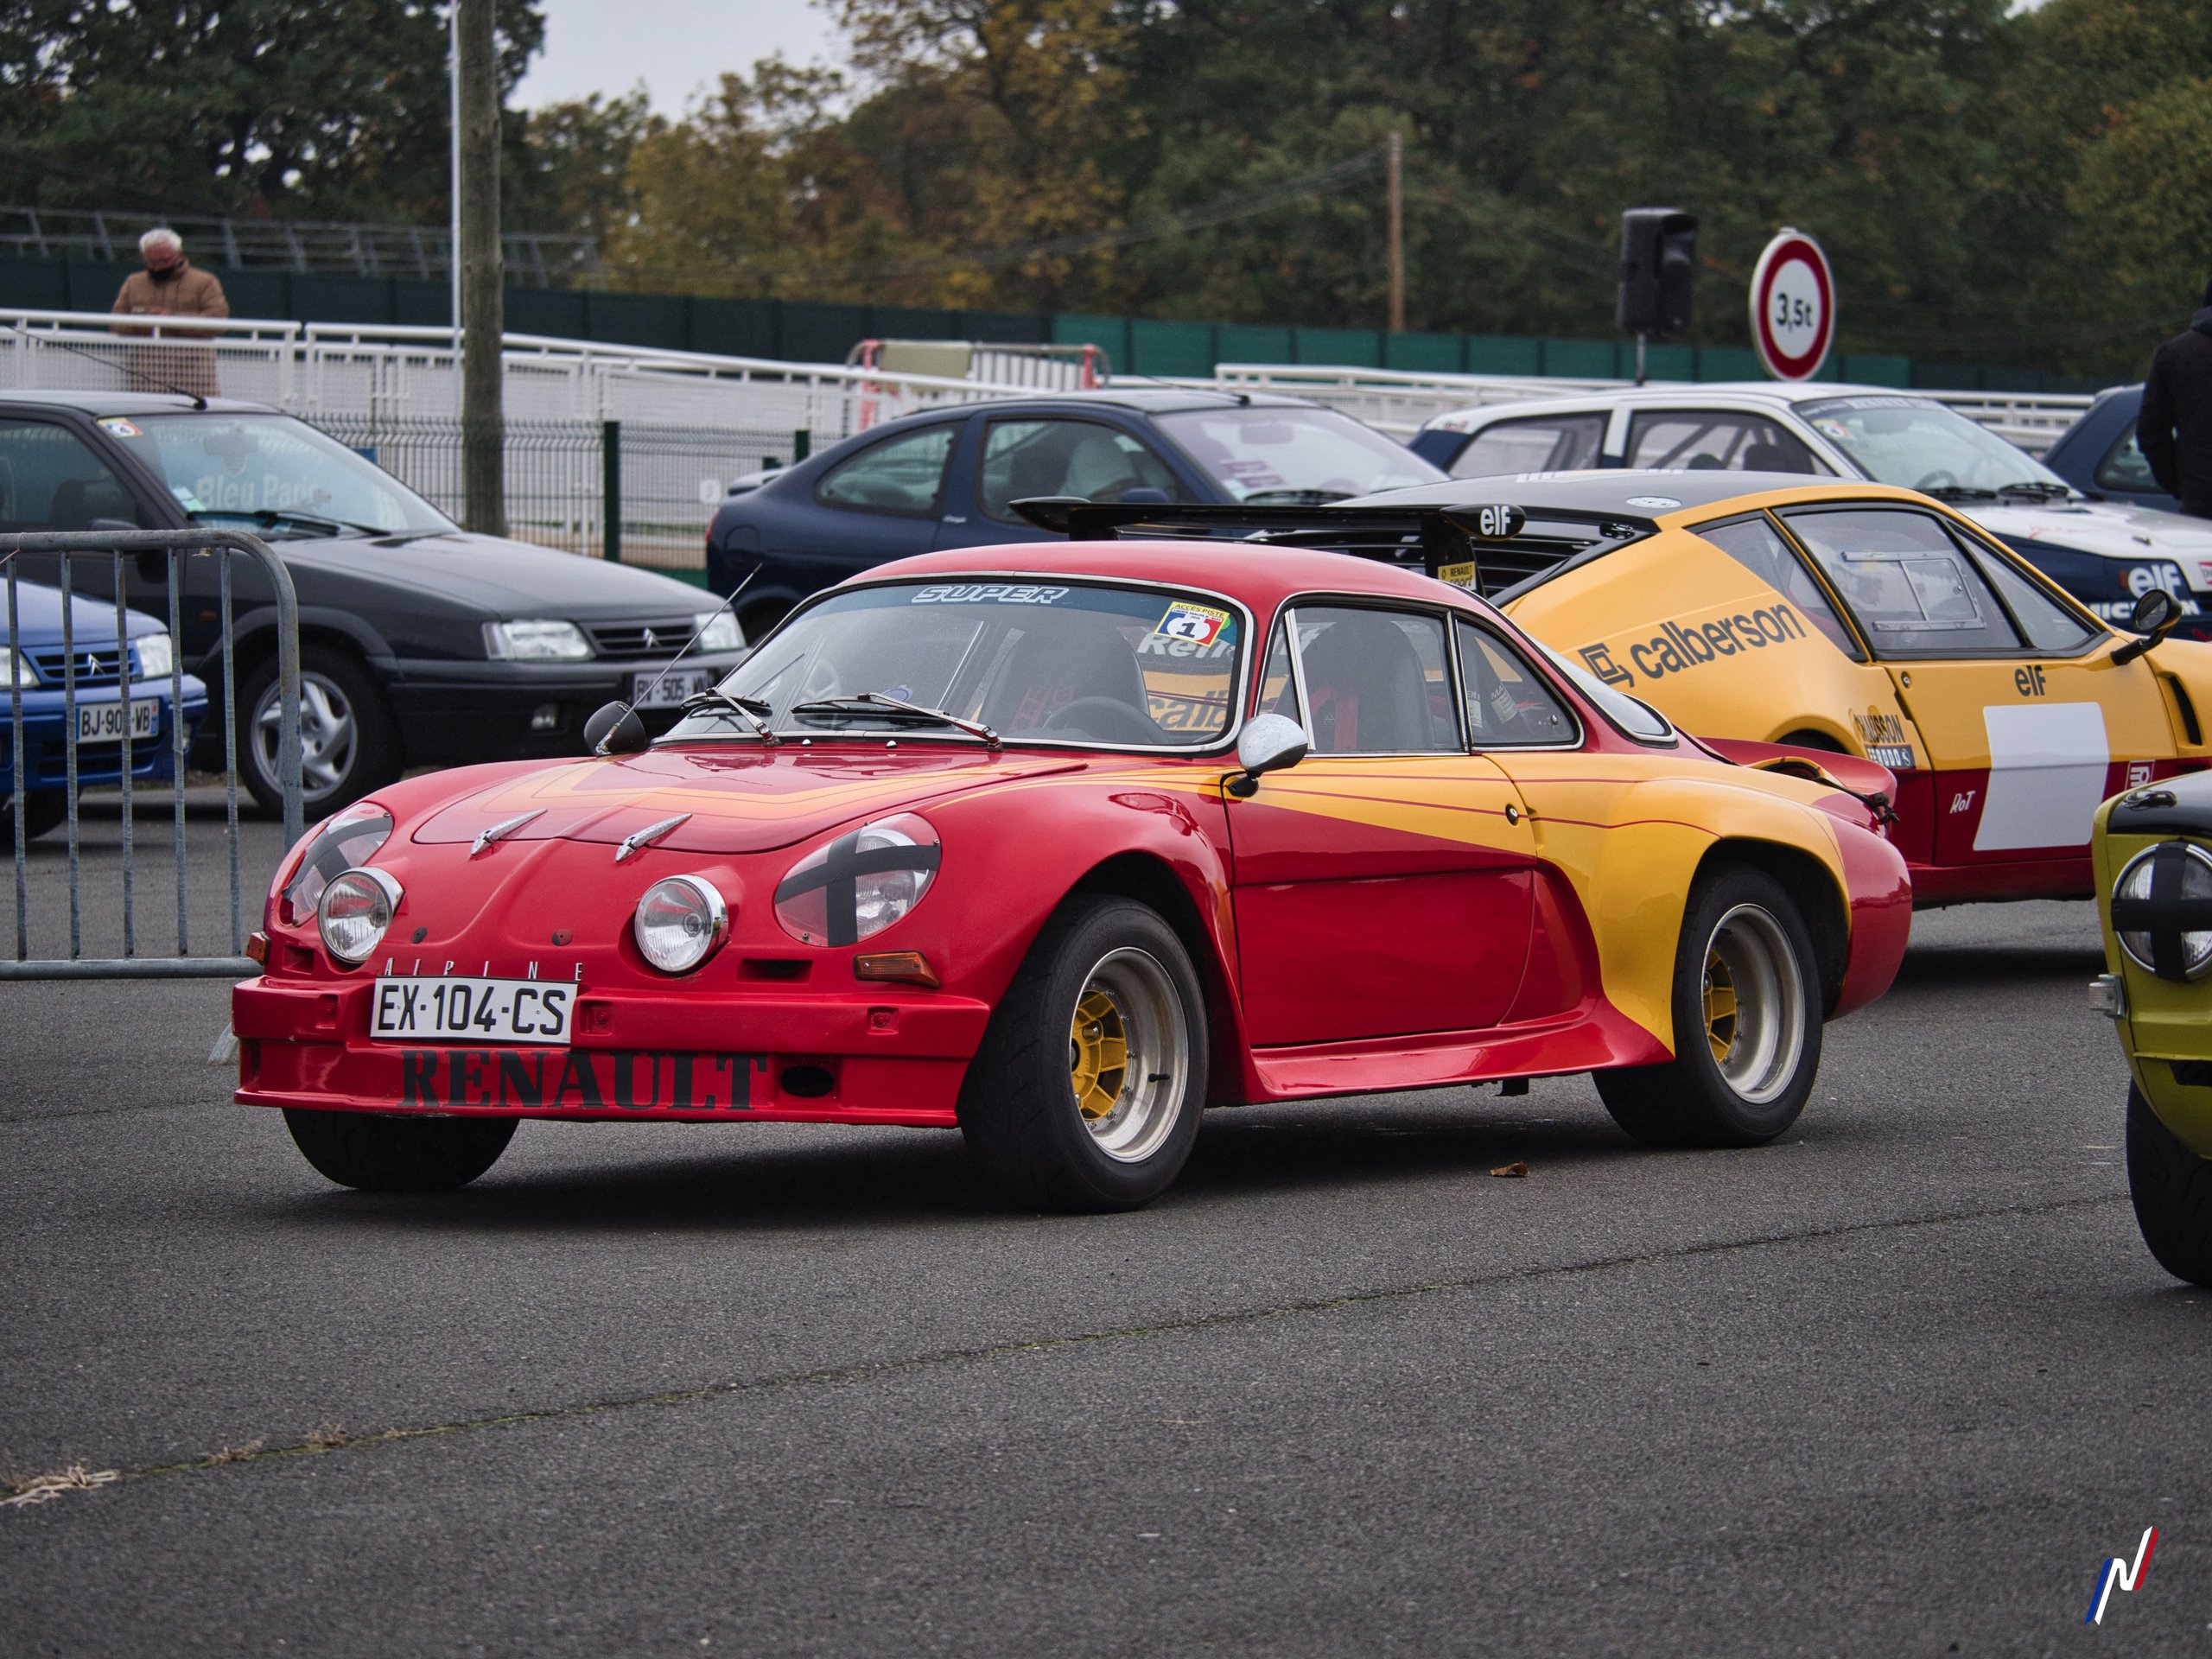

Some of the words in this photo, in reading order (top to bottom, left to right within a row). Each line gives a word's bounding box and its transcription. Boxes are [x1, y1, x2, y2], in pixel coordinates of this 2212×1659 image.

[1776, 292, 1813, 333] 3,5t
[196, 474, 257, 510] Bleu
[1480, 505, 1511, 536] elf
[1450, 564, 1472, 577] RENAULT
[2127, 563, 2182, 600] elf
[912, 585, 1070, 604] SUPER
[1202, 607, 1226, 618] PISTE
[1176, 621, 1197, 639] 1
[1630, 603, 1808, 679] calberson
[2014, 664, 2046, 696] elf
[81, 706, 150, 737] BJ-90-WB
[384, 957, 583, 982] ALPINE
[399, 1048, 769, 1111] RENAULT
